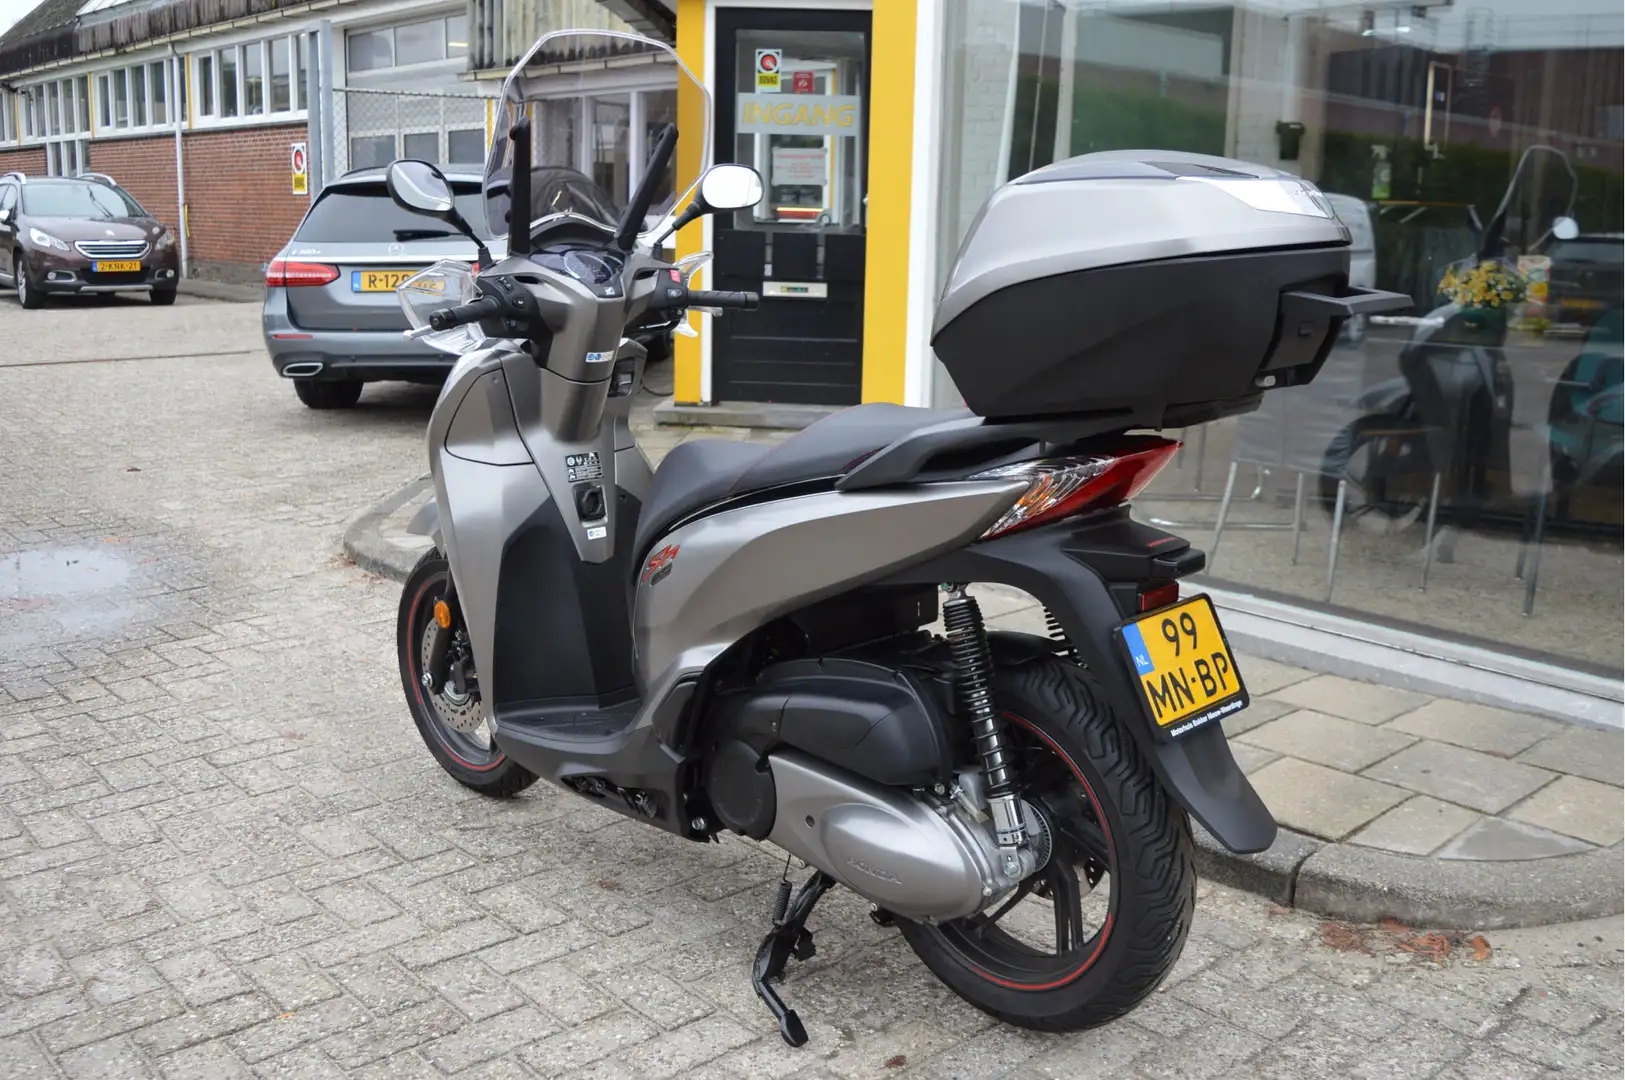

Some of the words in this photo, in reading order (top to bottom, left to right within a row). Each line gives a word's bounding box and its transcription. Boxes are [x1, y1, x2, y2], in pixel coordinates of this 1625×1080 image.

[743, 102, 855, 127] INGANG
[1162, 612, 1197, 657] 99
[1135, 654, 1149, 667] NL
[1146, 652, 1228, 718] MN-BP
